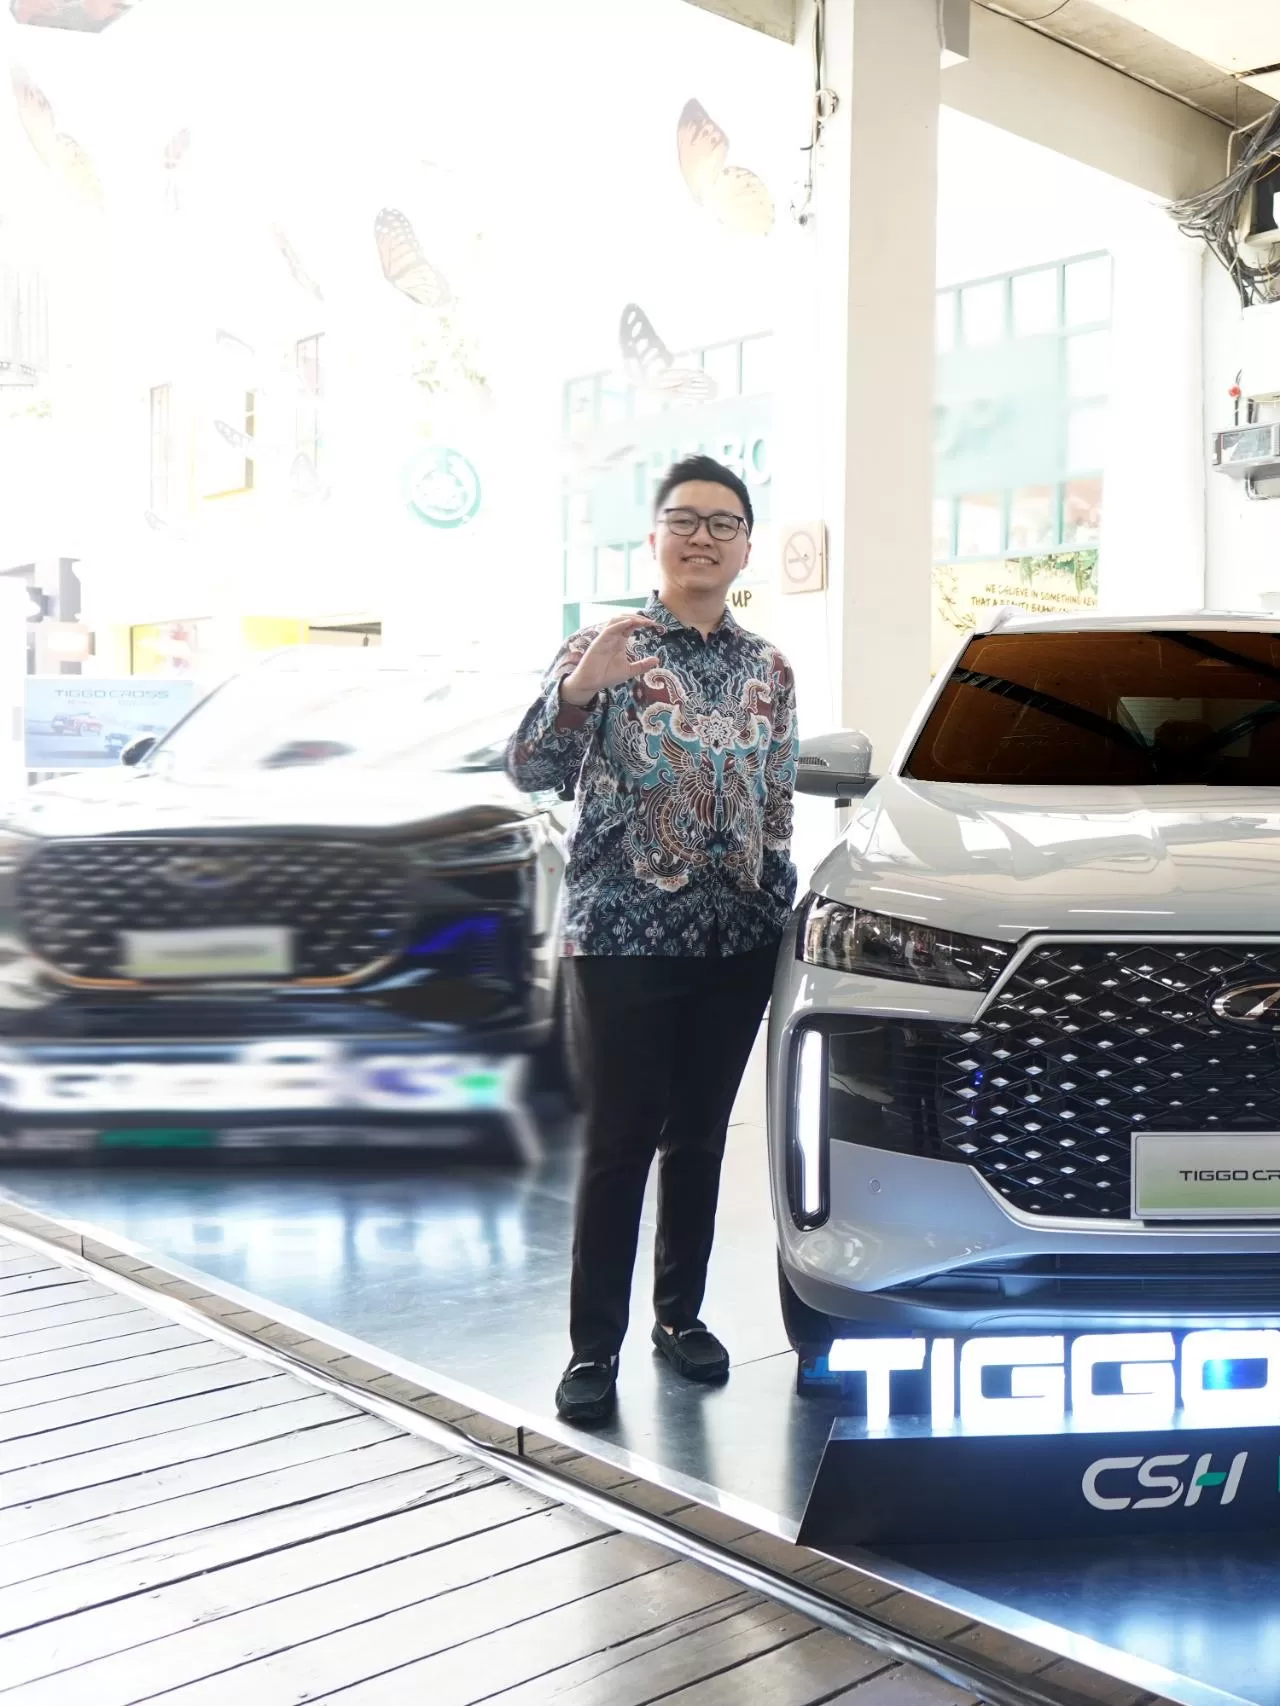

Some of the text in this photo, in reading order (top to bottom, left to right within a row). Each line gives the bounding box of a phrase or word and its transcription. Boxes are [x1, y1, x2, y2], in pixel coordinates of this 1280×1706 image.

[985, 584, 996, 593] WE
[971, 596, 990, 607] THAT
[54, 689, 169, 699] TIGGO CROSS
[1179, 1170, 1249, 1182] TIGGO
[1081, 1450, 1249, 1511] CSH
